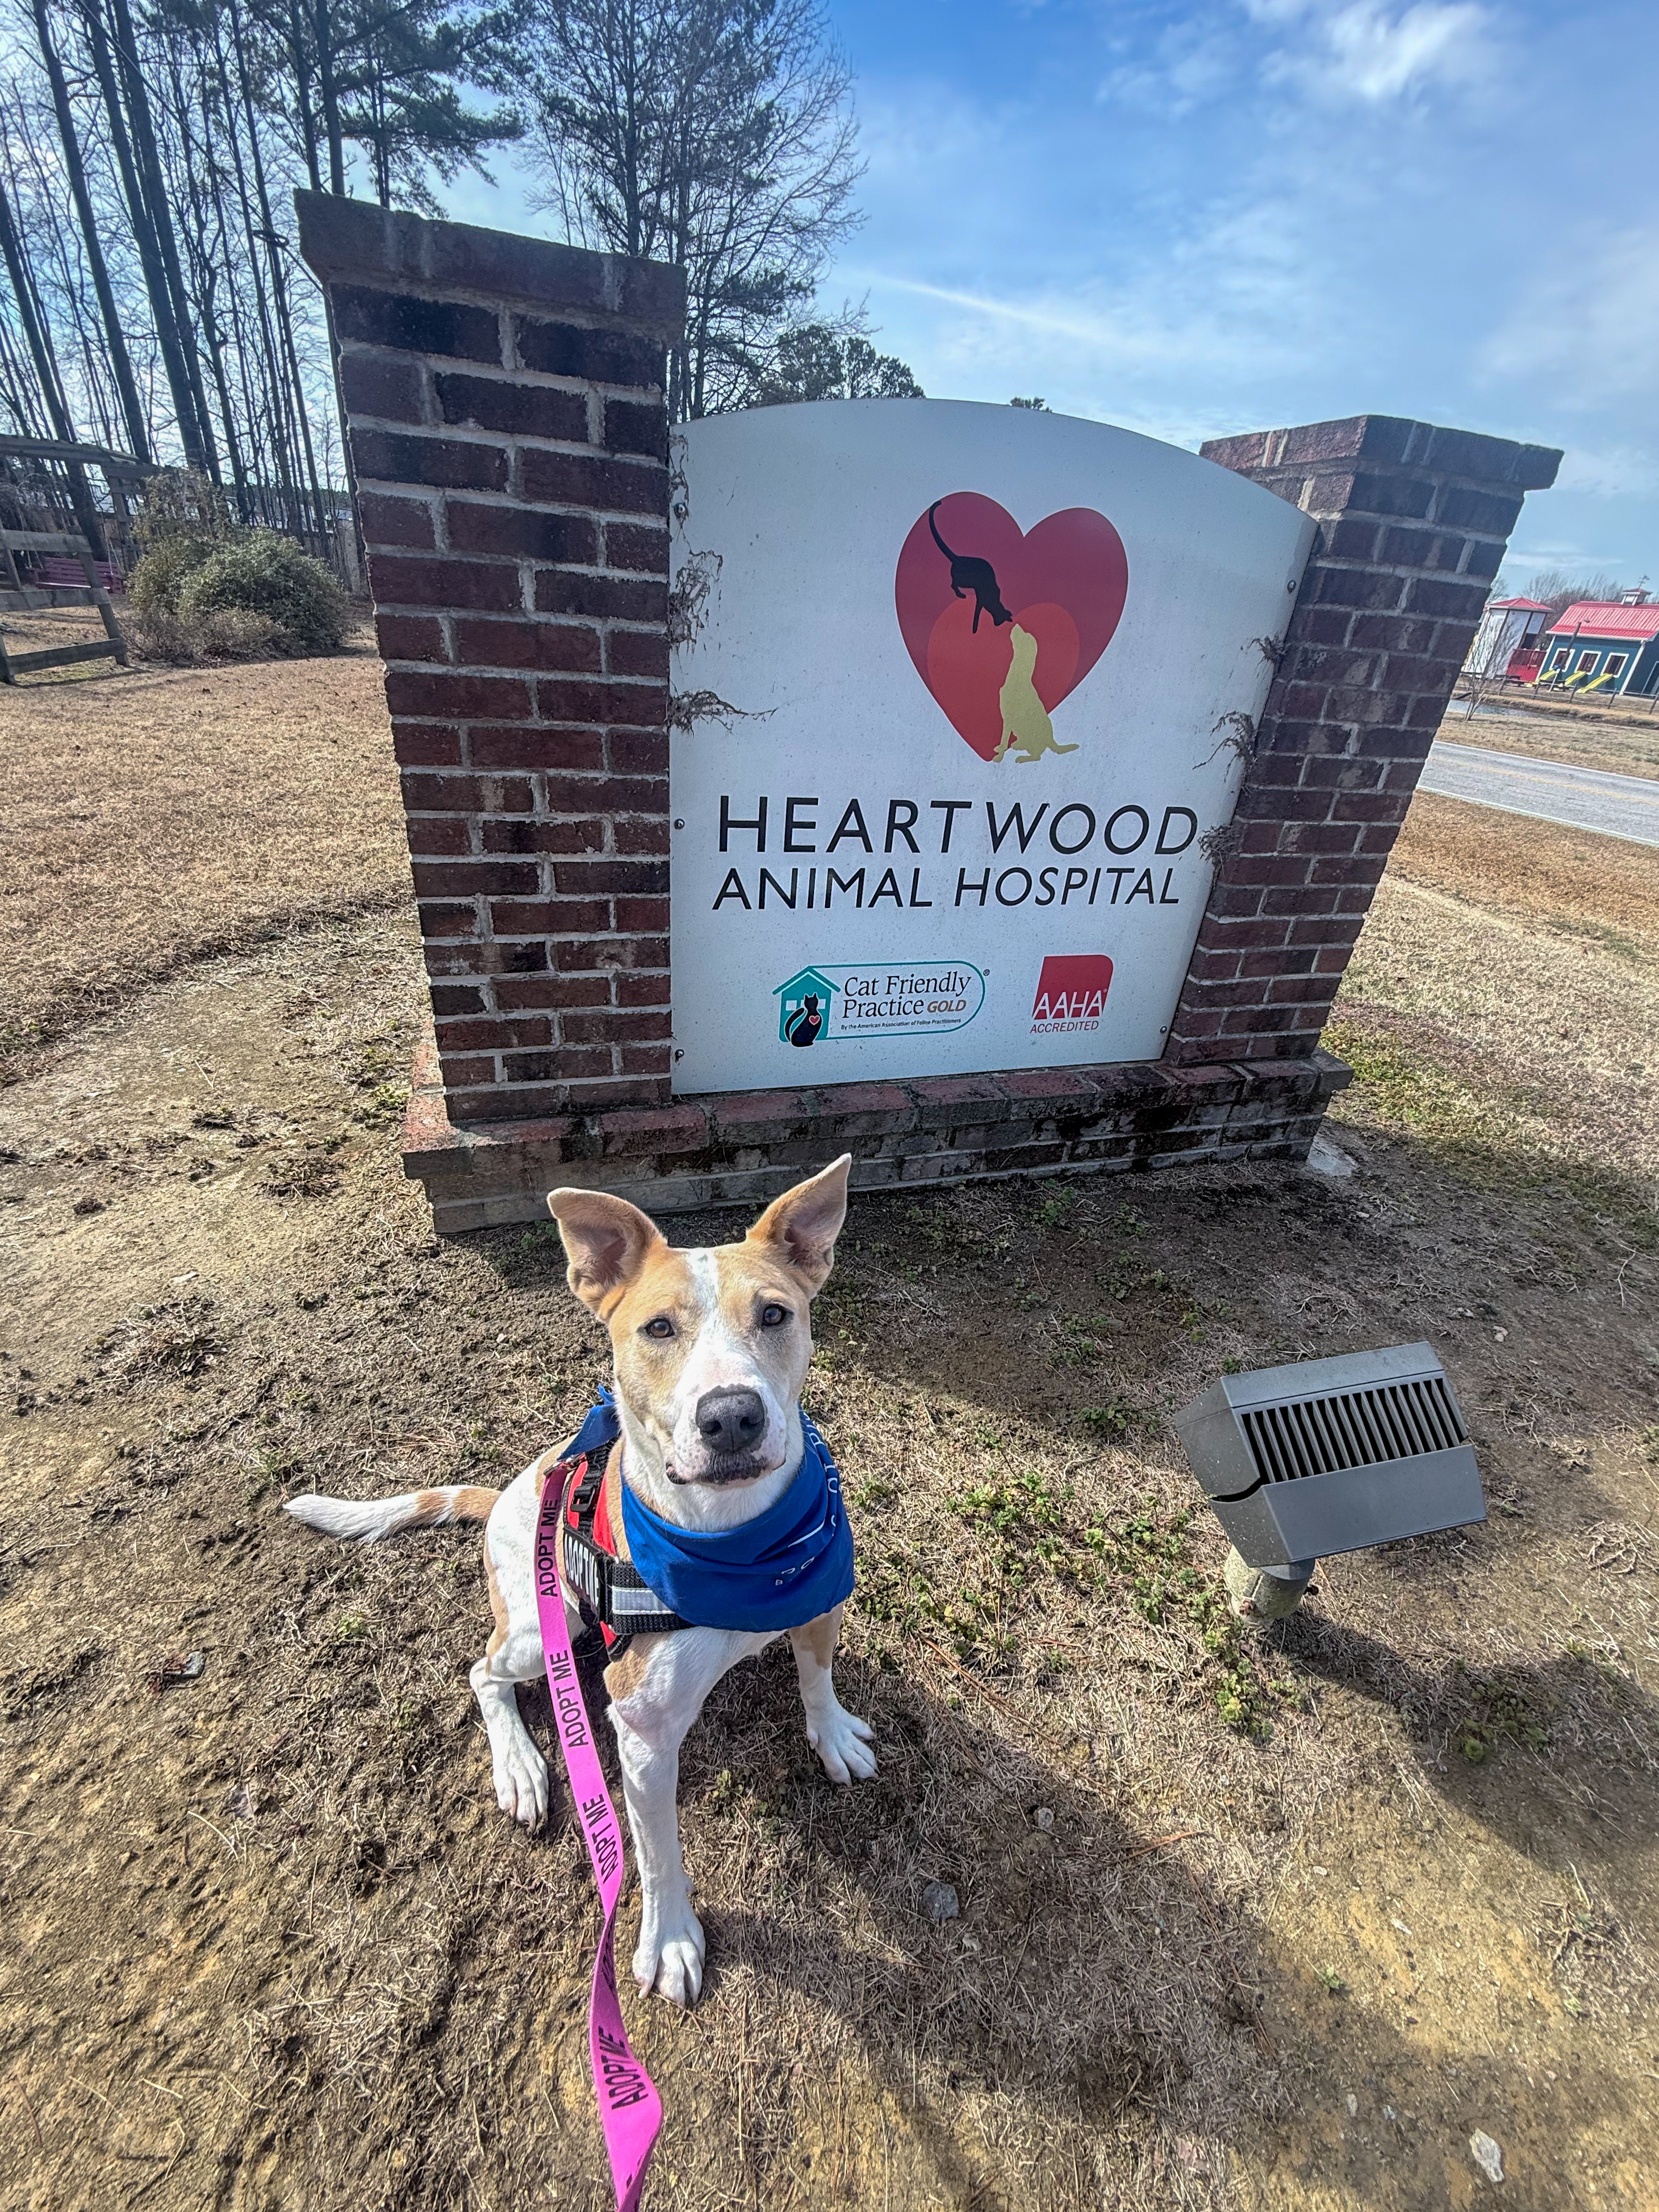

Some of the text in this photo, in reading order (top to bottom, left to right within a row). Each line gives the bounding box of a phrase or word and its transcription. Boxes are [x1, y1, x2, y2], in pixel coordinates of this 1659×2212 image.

[712, 867, 1180, 910] ANIMAL HOSPITAL
[844, 971, 972, 997] Cat Friendly
[1031, 990, 1103, 1021] AAHA
[842, 996, 967, 1018] Practice GOLD
[1030, 1021, 1099, 1034] ACCREDITED
[537, 1499, 558, 1598] ADOPT ME
[550, 1650, 588, 1748] ADOPT ME
[582, 1793, 619, 1884] ADOPT ME
[601, 2055, 649, 2110] ADOPT
